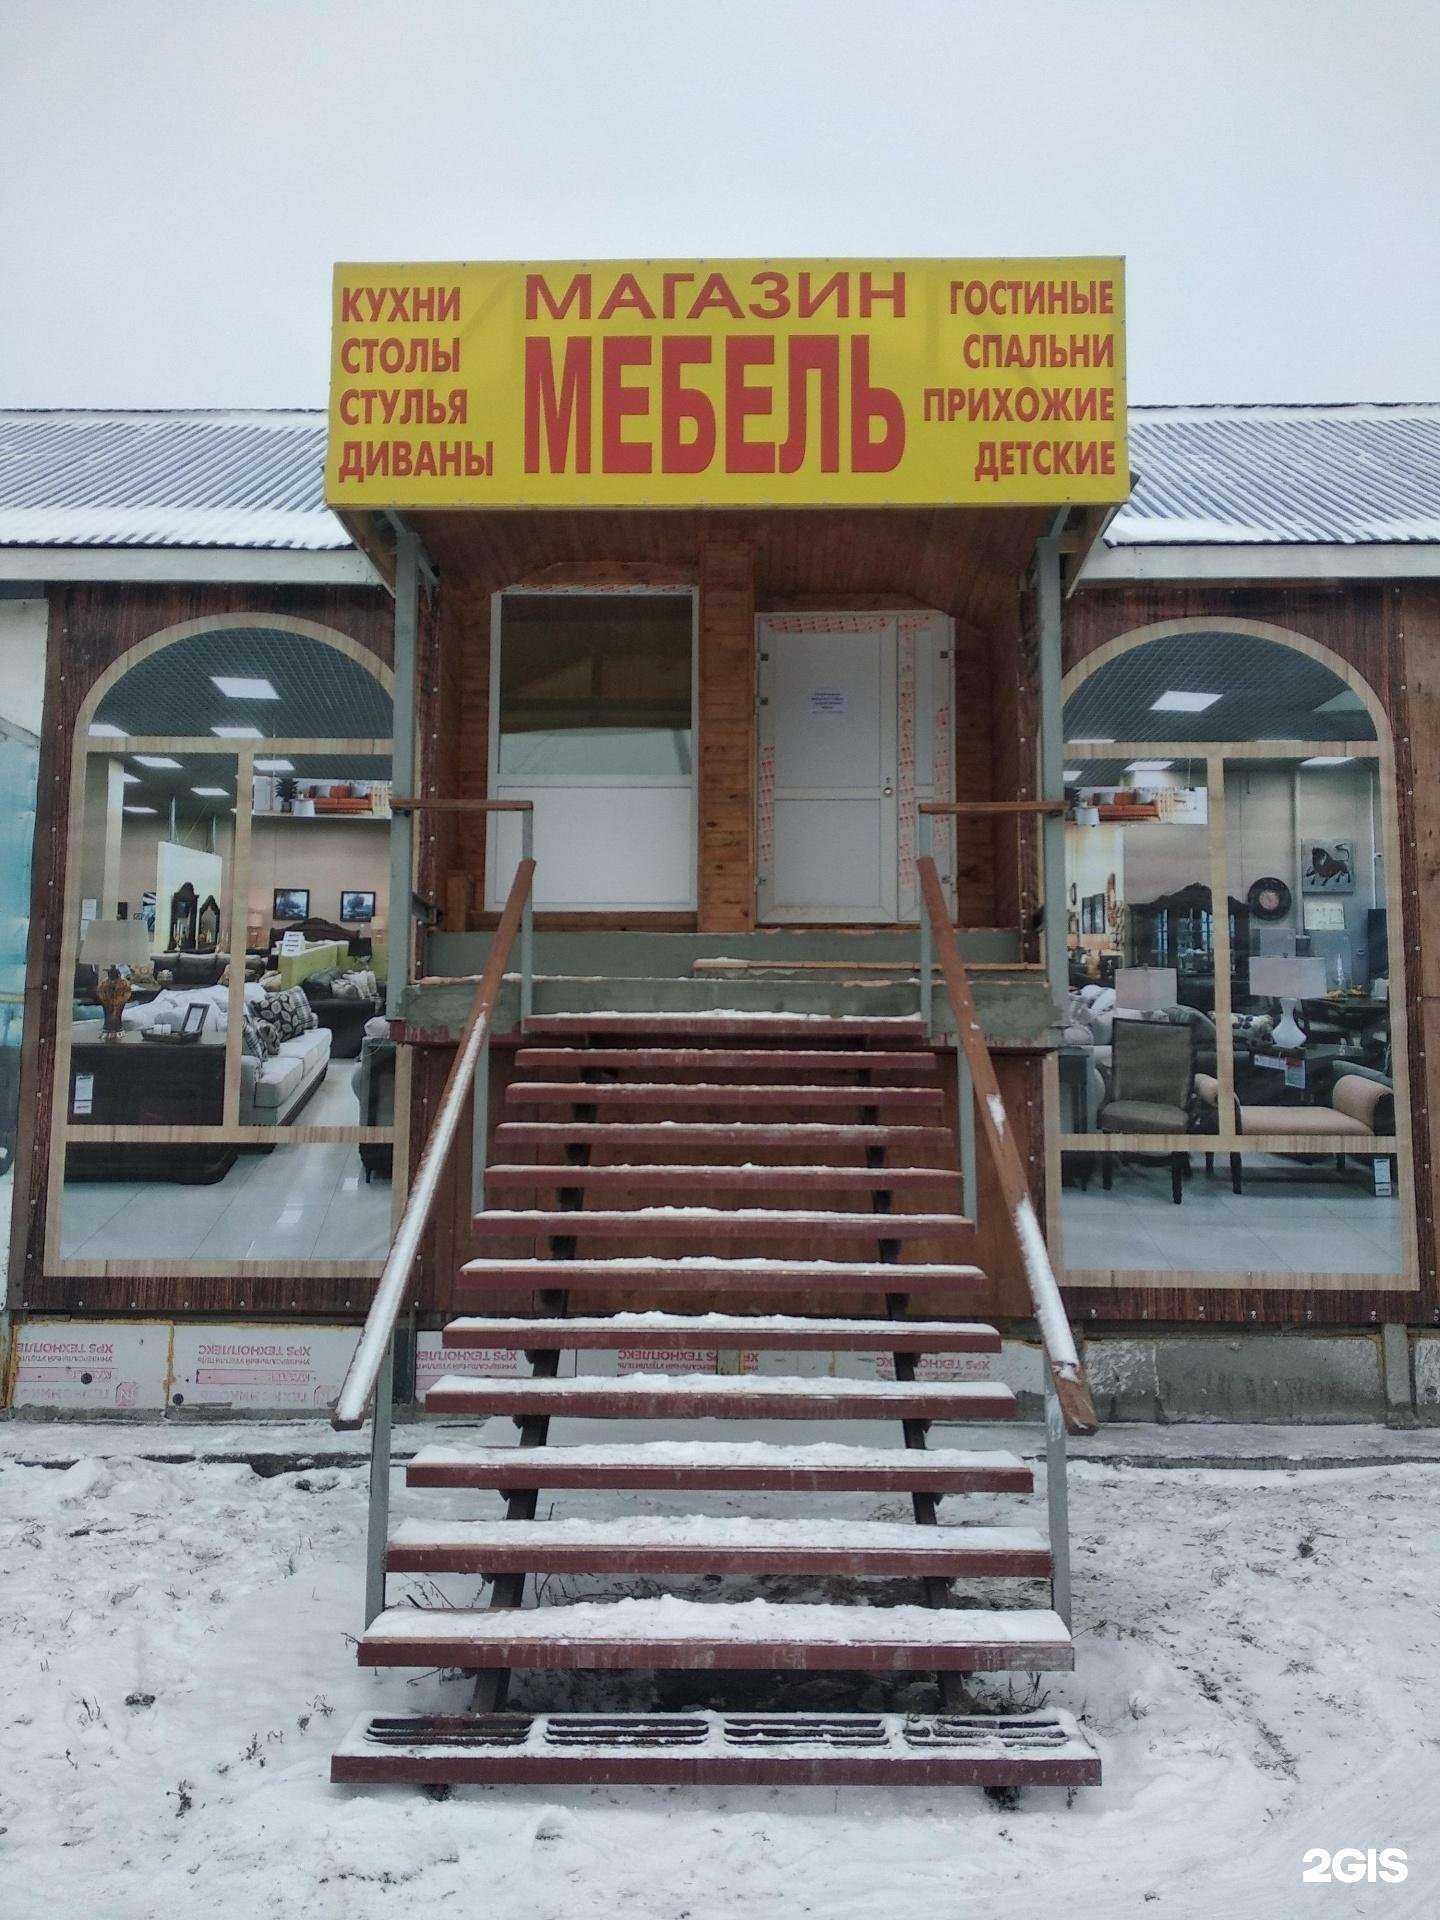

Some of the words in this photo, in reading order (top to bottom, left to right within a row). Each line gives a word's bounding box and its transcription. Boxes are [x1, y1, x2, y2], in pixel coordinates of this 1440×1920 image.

[341, 286, 461, 322] КУХНИ
[525, 272, 906, 320] МАГАЗИН
[950, 280, 1113, 316] ГОСТИНЫЕ
[341, 336, 461, 375] СТОЛЫ
[963, 333, 1114, 369] СПАЛЬНИ
[339, 388, 468, 425] СТУЛЬЯ
[524, 334, 906, 474] МЕБЕЛЬ
[923, 386, 1115, 422] ПРИХОЖИЕ
[338, 440, 494, 483] ДИВАНЫ
[974, 440, 1115, 482] ДЕТСКИЕ
